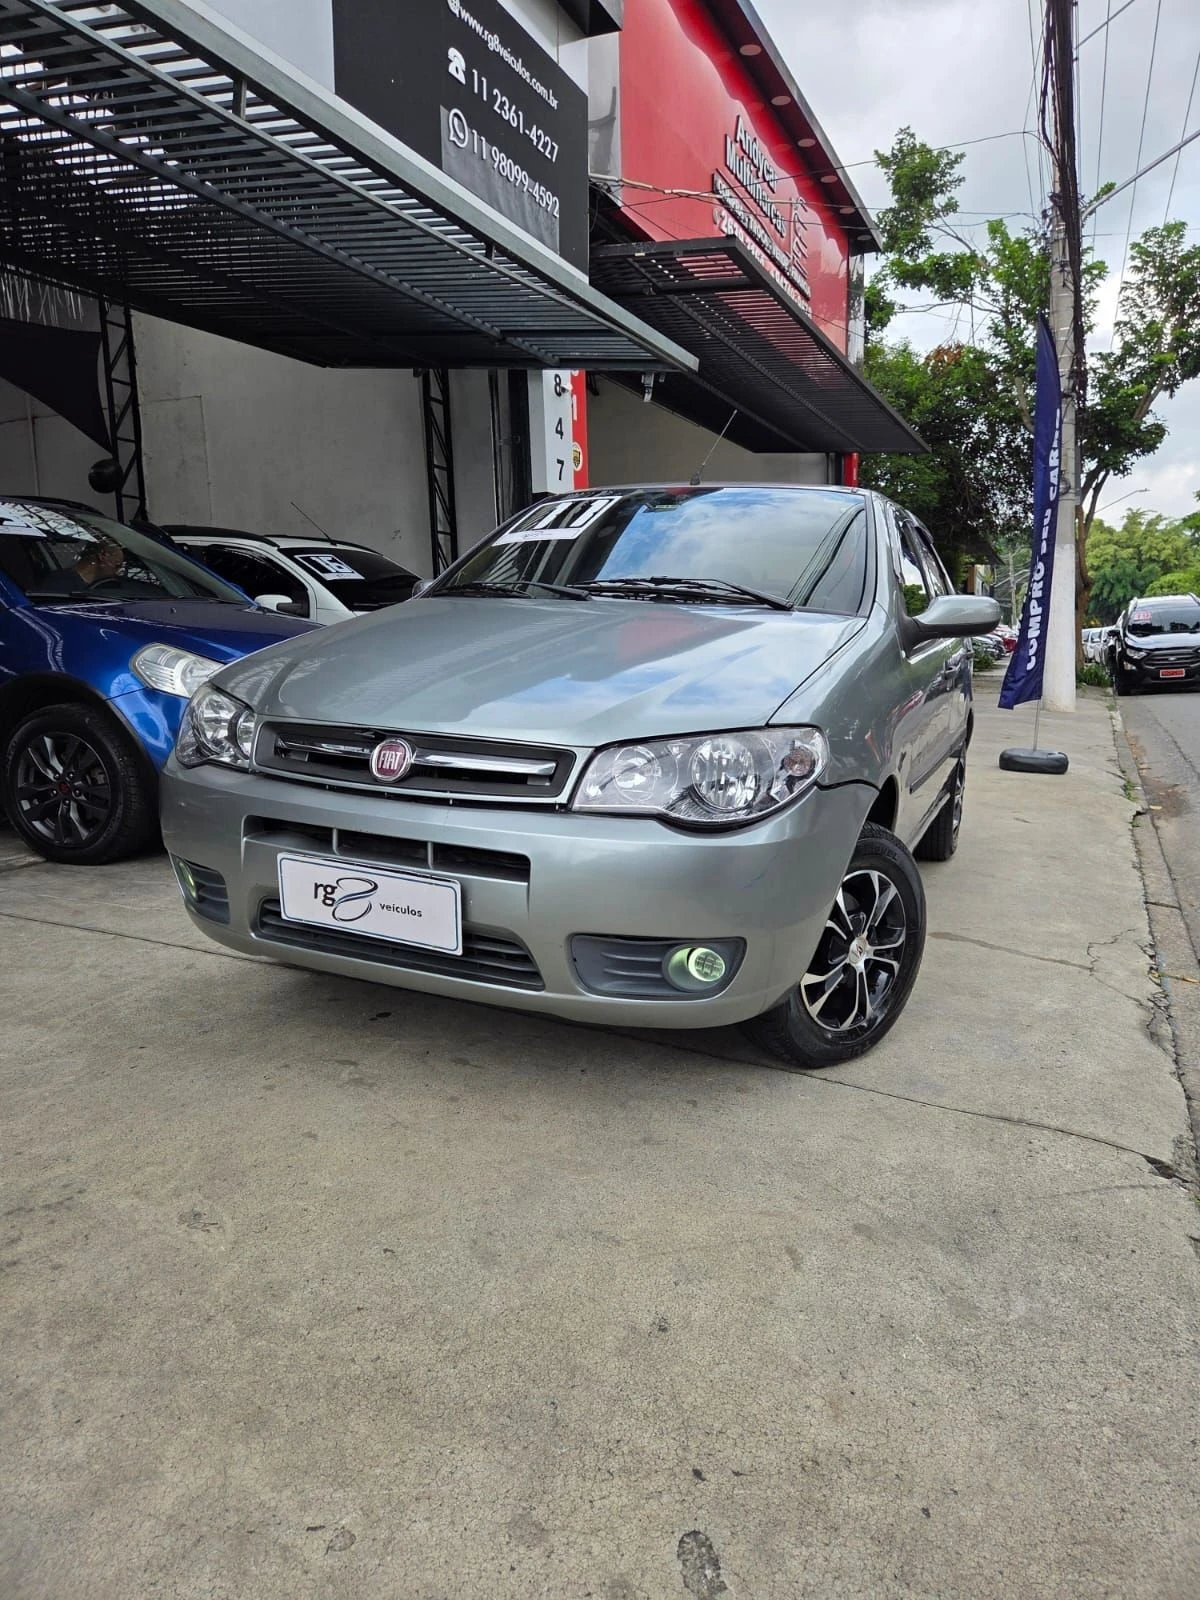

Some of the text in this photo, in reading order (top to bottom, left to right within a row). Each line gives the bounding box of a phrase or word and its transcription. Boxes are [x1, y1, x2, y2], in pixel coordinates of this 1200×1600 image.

[460, 6, 559, 110] www.rg8veiculos.com.br
[472, 69, 559, 163] 11 2361-4227
[736, 115, 777, 193] Andycar
[472, 129, 560, 218] 11 98099-4592
[726, 134, 787, 238] Multimarcas
[378, 751, 402, 771] FIAT
